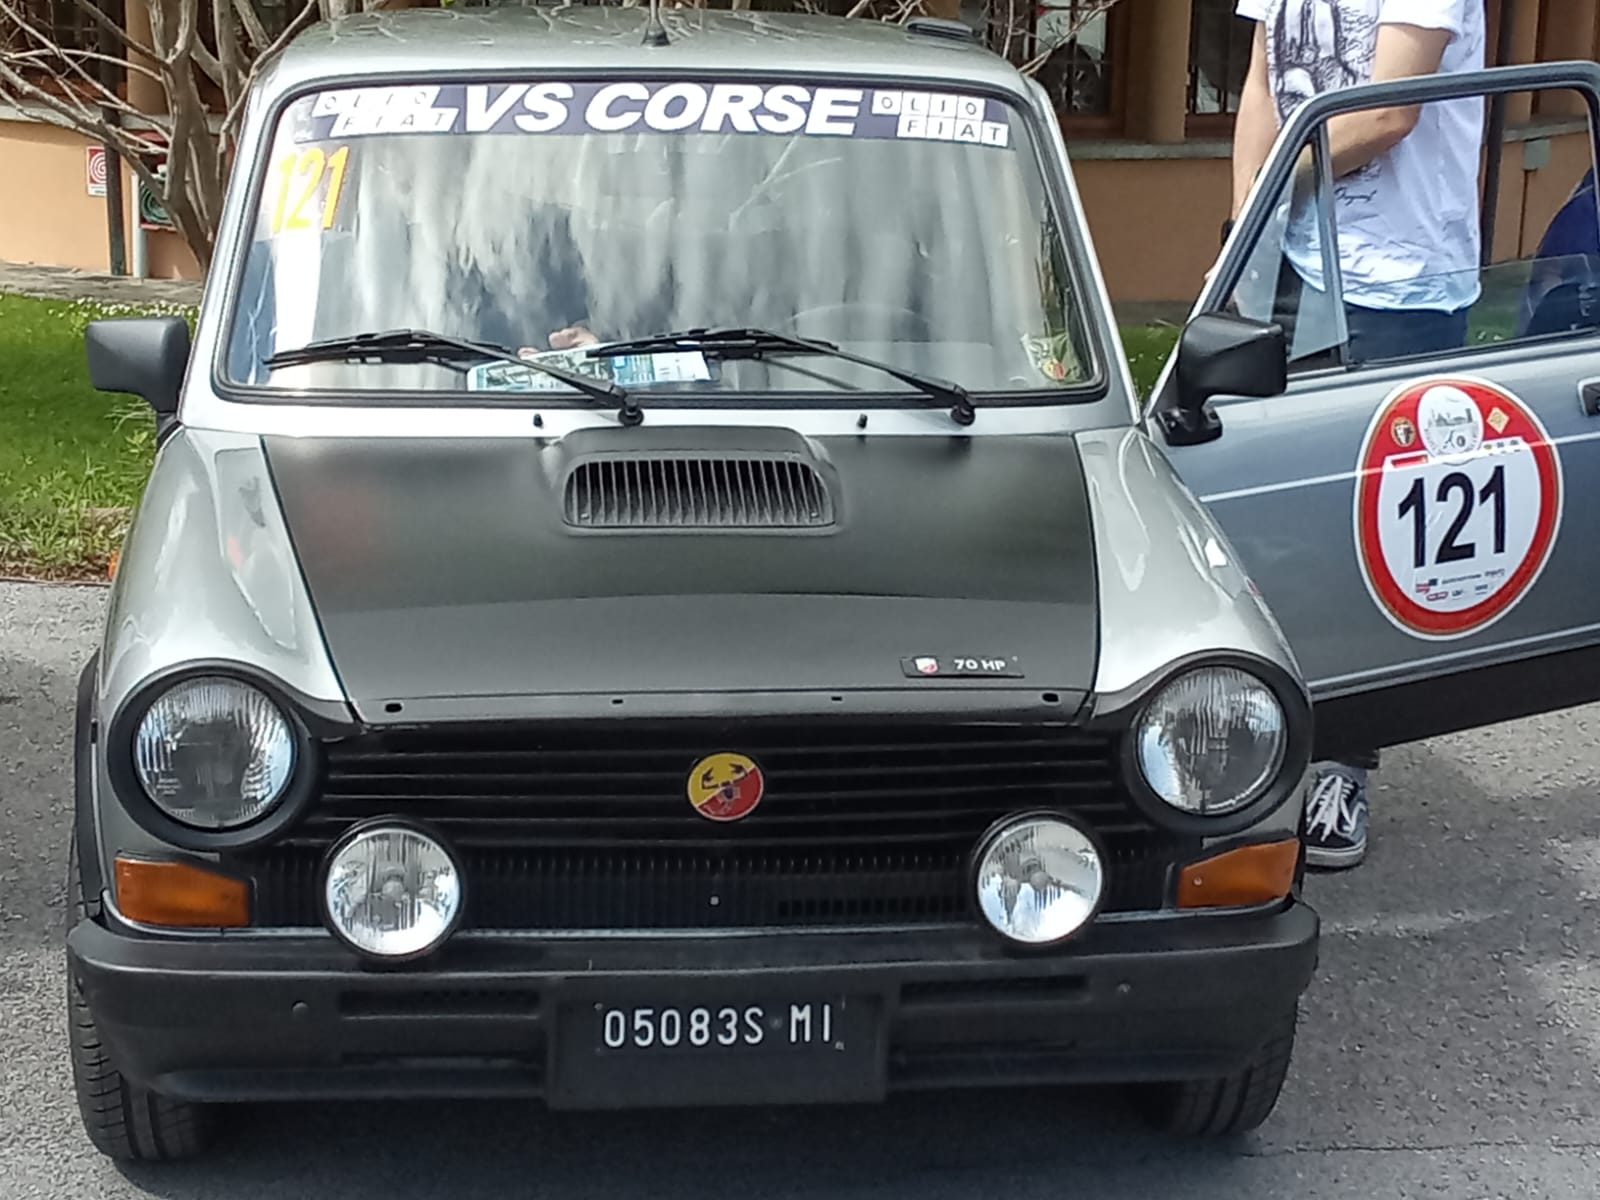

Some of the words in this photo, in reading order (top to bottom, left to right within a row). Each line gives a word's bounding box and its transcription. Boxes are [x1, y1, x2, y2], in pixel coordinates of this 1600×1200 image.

[343, 112, 446, 131] FIAT
[465, 82, 575, 133] VS
[584, 82, 863, 136] CORSE
[881, 96, 977, 116] OLIO
[907, 119, 1001, 141] FIAT
[271, 144, 349, 234] 121
[1397, 465, 1505, 569] 121
[953, 658, 979, 671] 70
[980, 659, 1006, 671] HP
[604, 1006, 764, 1048] 05083S
[790, 1003, 831, 1044] MI
